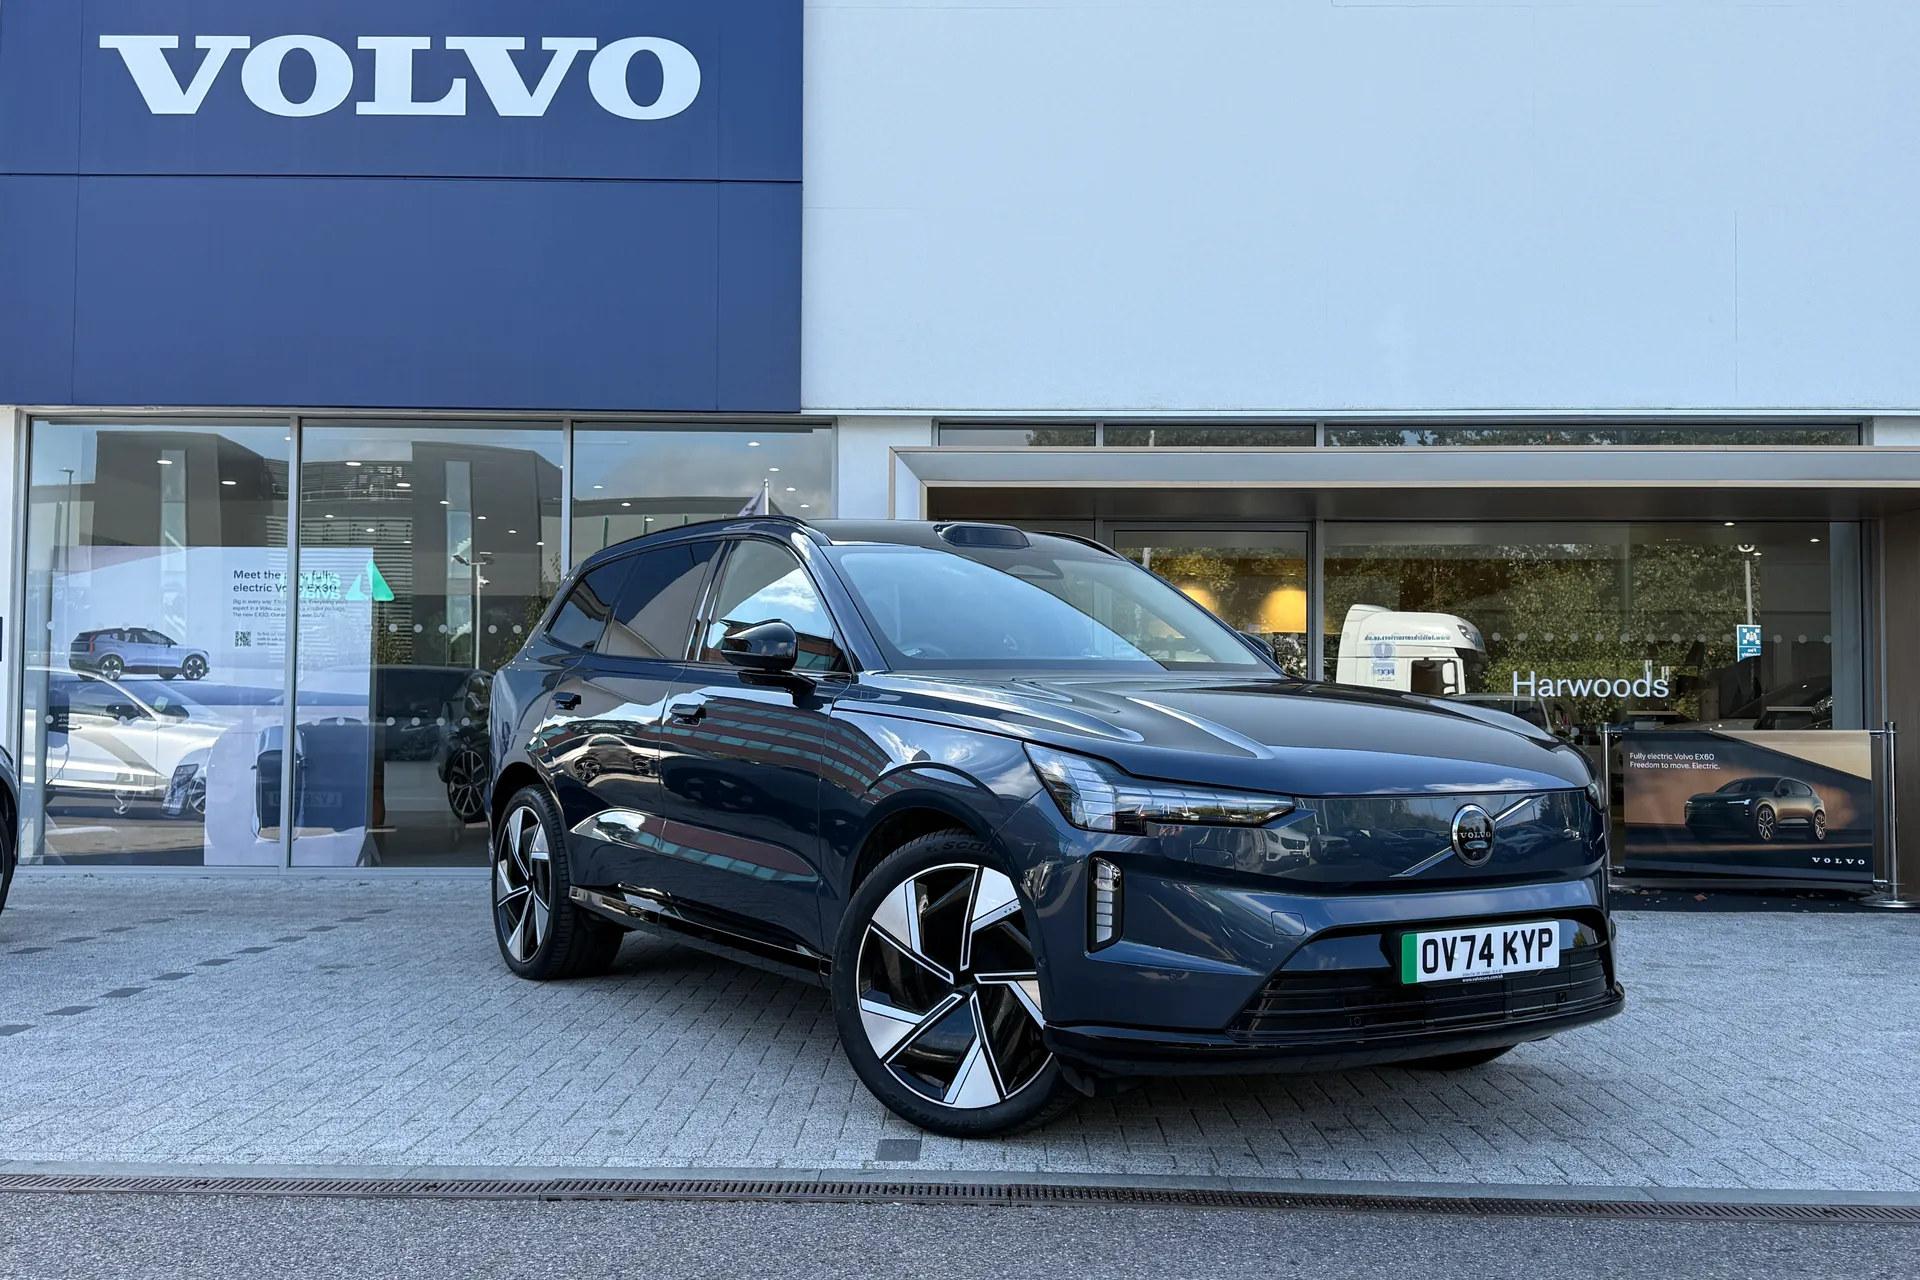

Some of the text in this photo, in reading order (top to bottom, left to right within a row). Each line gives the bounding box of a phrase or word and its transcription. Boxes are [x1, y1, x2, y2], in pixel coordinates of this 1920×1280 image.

[99, 34, 701, 120] VOLVO
[233, 570, 261, 580] Meet
[264, 570, 281, 580] the
[312, 570, 335, 582] fully
[233, 583, 337, 593] electric Voo EX30
[1512, 670, 1670, 698] Harwoods
[1629, 752, 1646, 760] Fully
[1629, 761, 1660, 769] Freedom
[1692, 762, 1720, 770] Electric.
[1811, 856, 1866, 865] VOLVO
[1422, 928, 1553, 974] OV74 KYP
